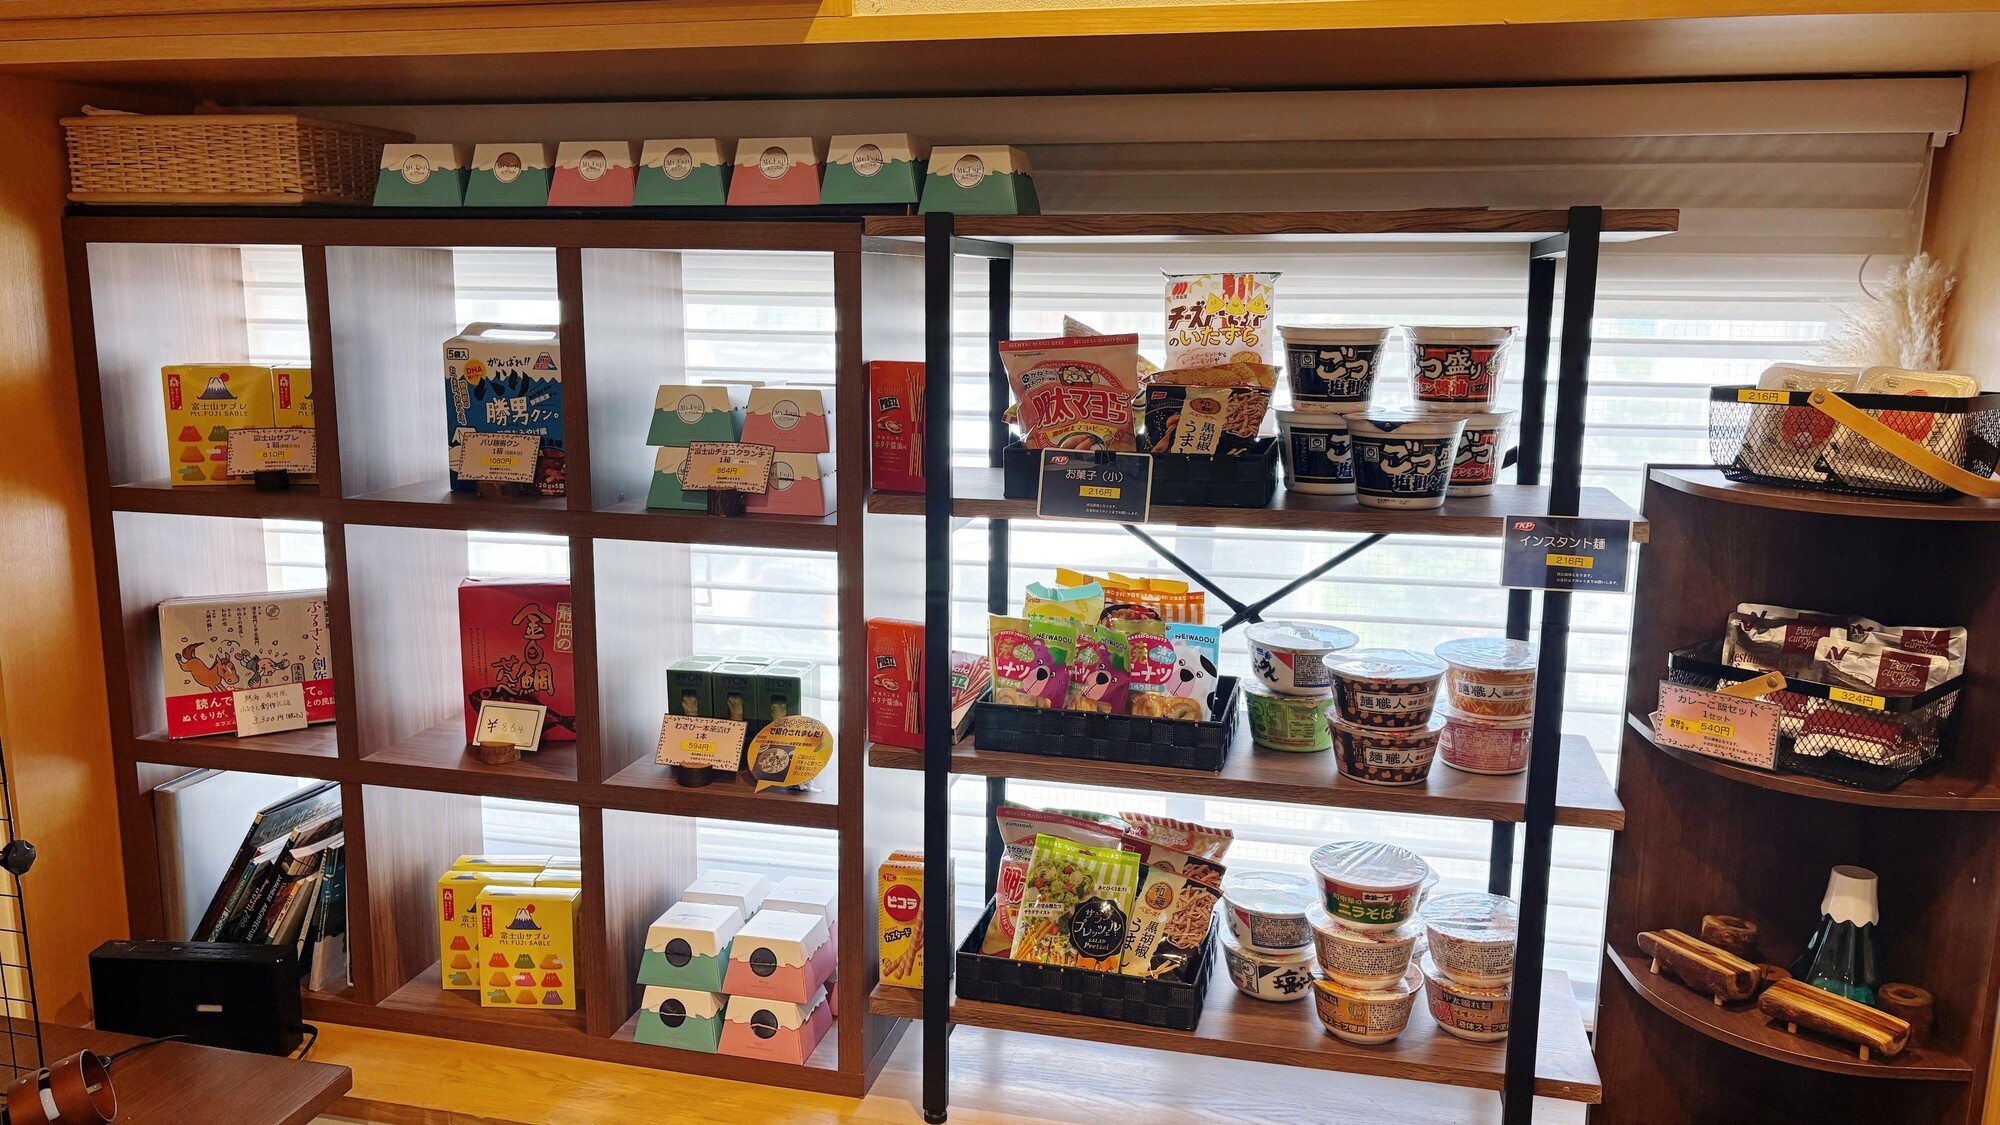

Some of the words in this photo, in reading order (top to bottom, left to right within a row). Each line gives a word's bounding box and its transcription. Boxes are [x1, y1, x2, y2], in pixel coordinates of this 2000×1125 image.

[1169, 326, 1259, 347] のいたずら
[448, 350, 468, 359] 5袋入
[486, 356, 531, 367] がんばれ!!
[466, 366, 482, 375] DHA
[1749, 391, 1779, 403] 216円
[191, 402, 247, 410] 富士山サブレ
[1196, 421, 1215, 451] 黒胡椒
[480, 439, 520, 447] バリ勝男クン
[694, 447, 766, 458] 富士山チョコクランチ
[716, 467, 738, 475] 864円
[1065, 469, 1124, 483] お菓子（小）
[1088, 488, 1112, 497] 216円
[1513, 521, 1534, 529] TKP
[1519, 535, 1606, 550] インスタント麺
[1556, 556, 1584, 566] 216円
[1788, 635, 1812, 645] curry
[512, 603, 556, 697] 金目鯛
[491, 655, 521, 702] せんべ
[676, 673, 702, 682] IPPON
[721, 676, 748, 686] IPPON
[765, 678, 792, 688] IPPON
[1881, 669, 1905, 680] curry
[1900, 675, 1921, 688] pro
[302, 686, 323, 697] て。
[1458, 681, 1502, 698] 麺職人
[1360, 695, 1407, 710] 麺職人
[1840, 691, 1873, 706] 324円
[1677, 694, 1758, 718] カレーご飯セット
[1702, 710, 1731, 722] 1セット
[769, 727, 824, 738] で紹介されました!
[1700, 722, 1730, 736] 540円
[688, 742, 710, 751] 594円
[1368, 750, 1415, 765] 麺職人
[267, 873, 283, 903] JAPANESE
[1003, 866, 1027, 905] 明
[887, 895, 918, 910] ピコラ
[1337, 902, 1397, 920] ニラそば
[245, 902, 268, 942] ARCHITECTURE
[500, 932, 550, 940] 富士山サブレ
[884, 928, 912, 942] カスタード
[1134, 920, 1160, 959] 黒胡椒
[1083, 942, 1110, 951] Pretzel
